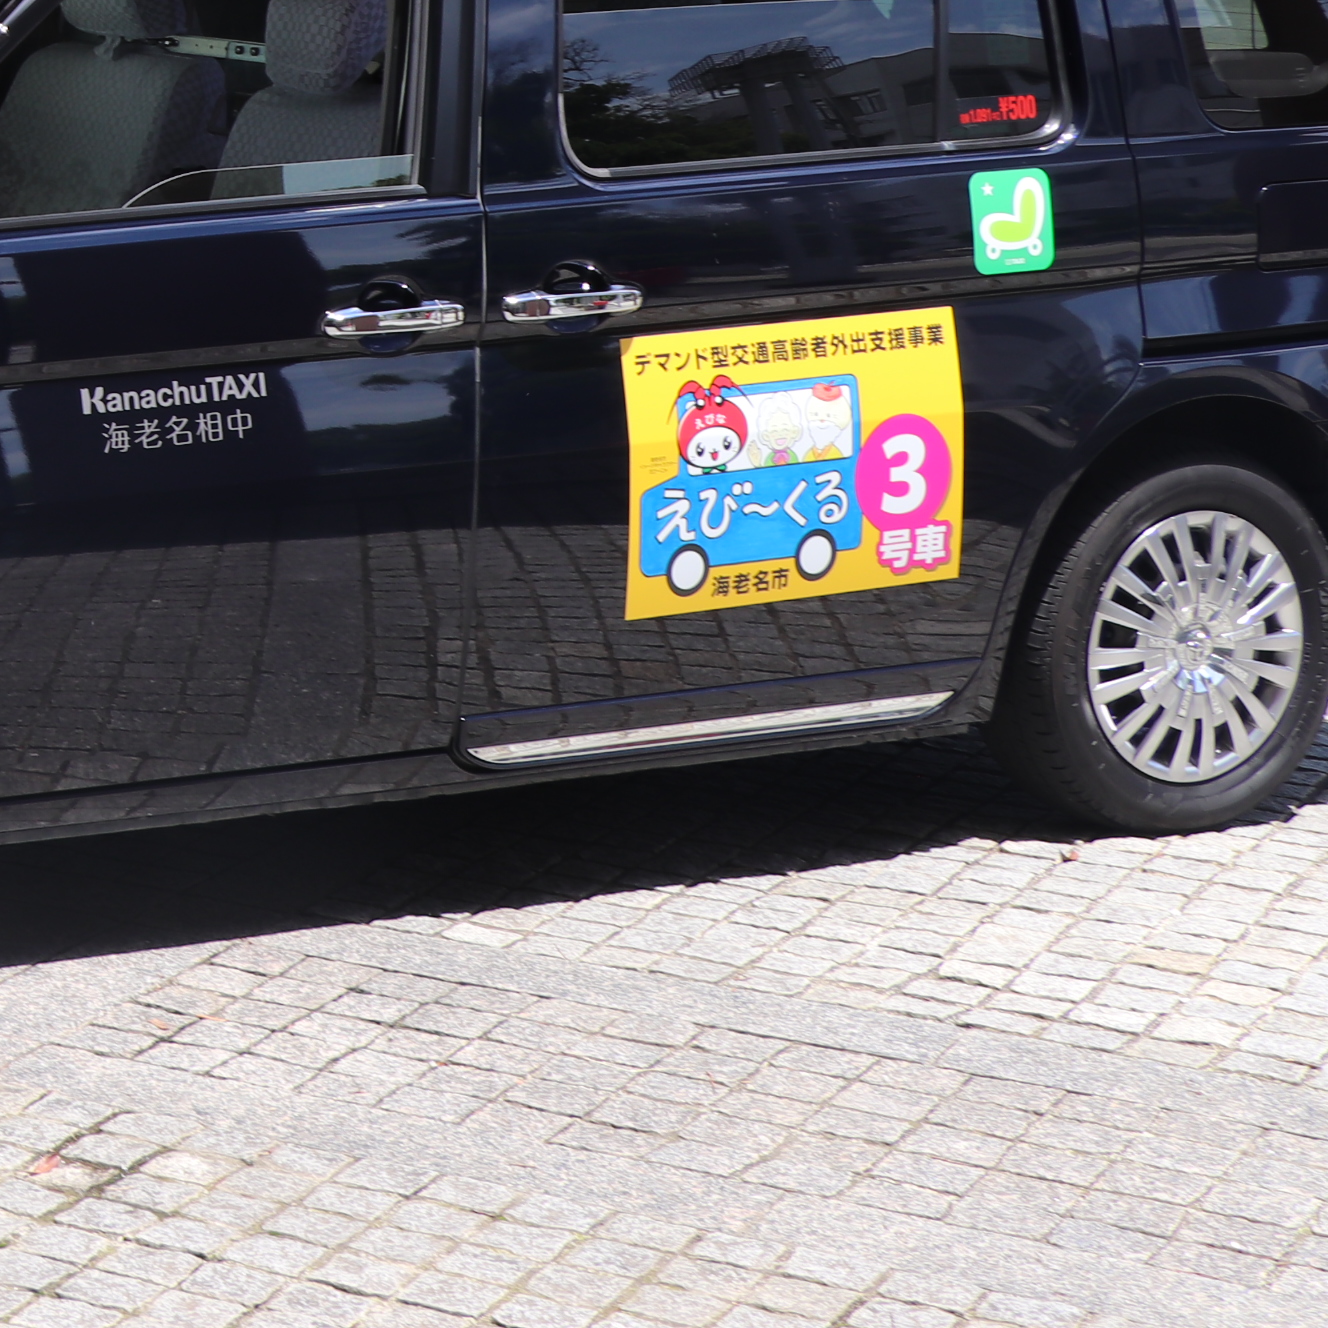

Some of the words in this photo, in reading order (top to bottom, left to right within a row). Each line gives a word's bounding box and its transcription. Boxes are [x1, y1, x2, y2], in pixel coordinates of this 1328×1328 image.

[998, 94, 1038, 120] ¥500
[634, 322, 946, 376] デマンド型交通高齢者外出支援事業
[80, 371, 268, 416] KanachuTAXI
[101, 408, 254, 455] 海老名相中
[693, 411, 728, 430] えびな
[879, 432, 928, 516] 3
[877, 523, 951, 569] 号車
[710, 566, 791, 600] 海老名市
